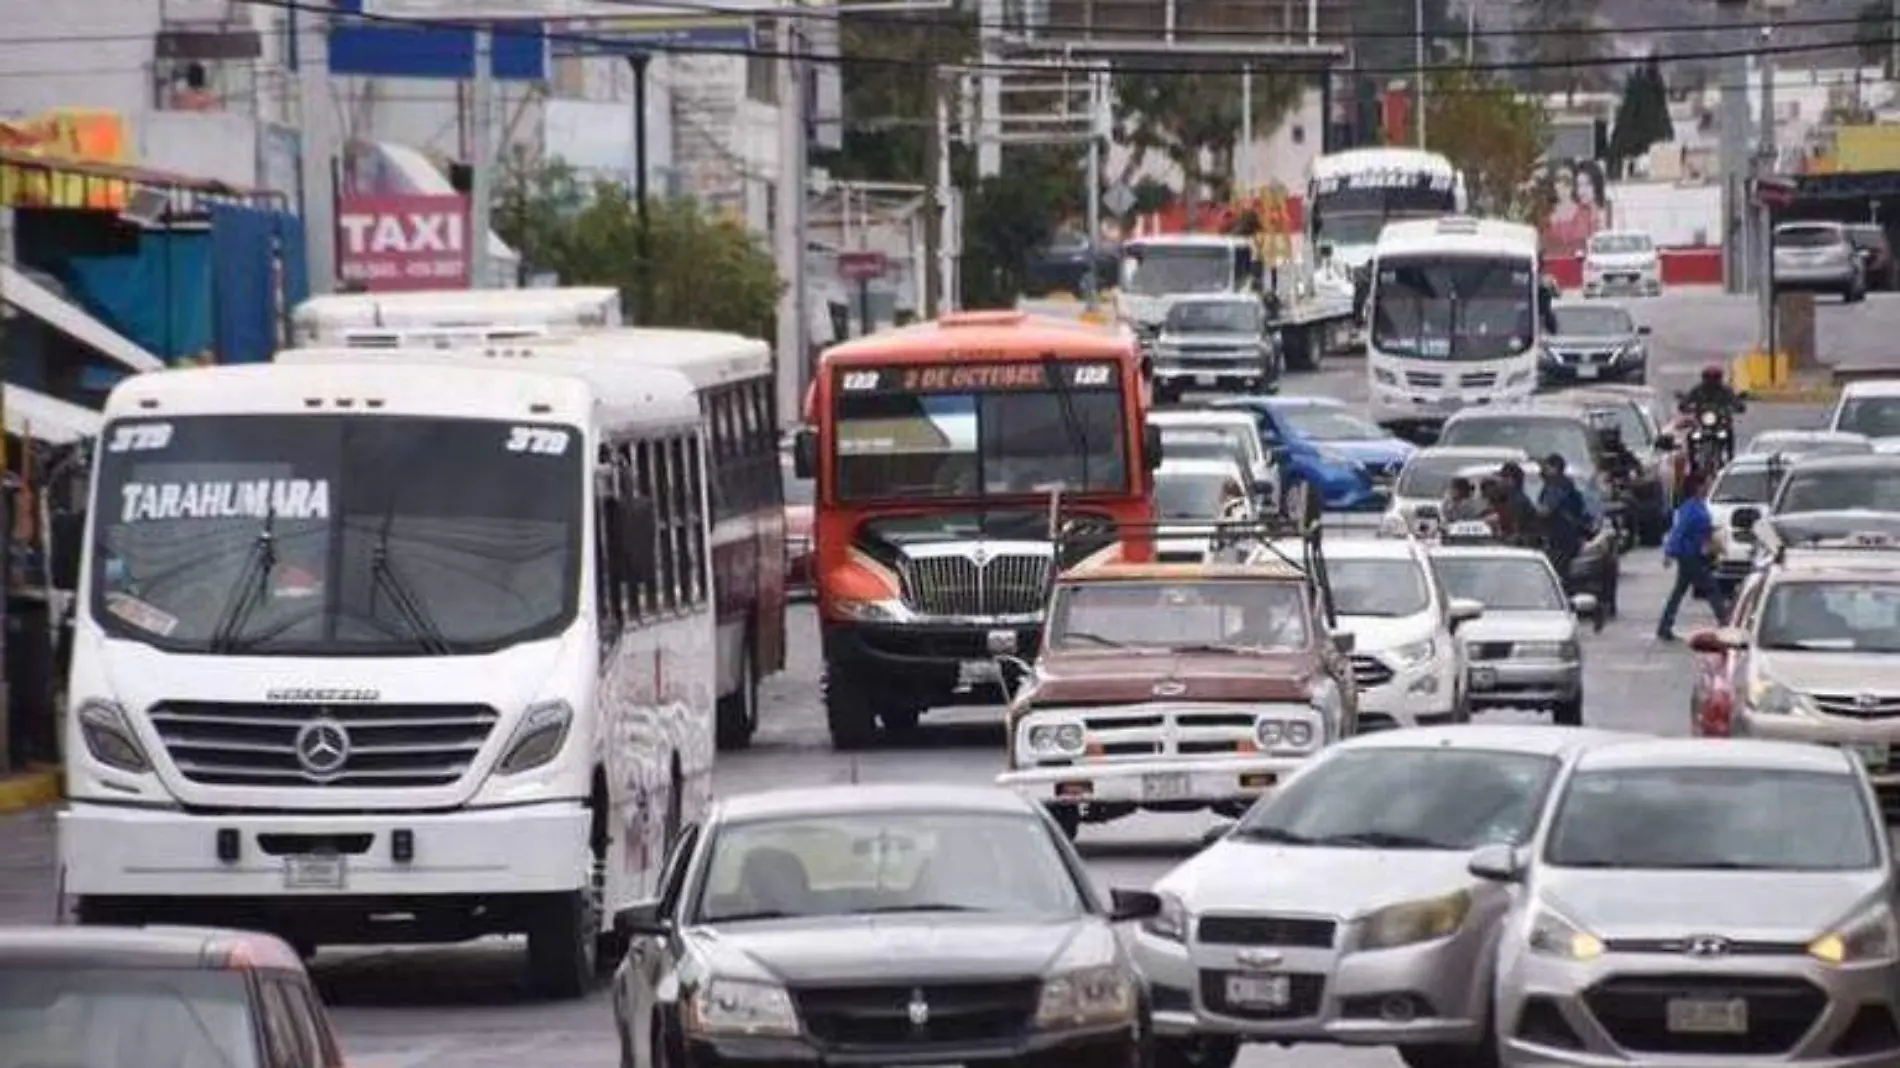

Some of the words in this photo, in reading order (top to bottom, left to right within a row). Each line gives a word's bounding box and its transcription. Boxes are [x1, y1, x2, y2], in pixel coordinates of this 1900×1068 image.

[340, 213, 463, 253] TAXI
[921, 367, 949, 389] DE
[951, 363, 1044, 388] OCTUBRE
[121, 479, 330, 522] TARAHUMARA
